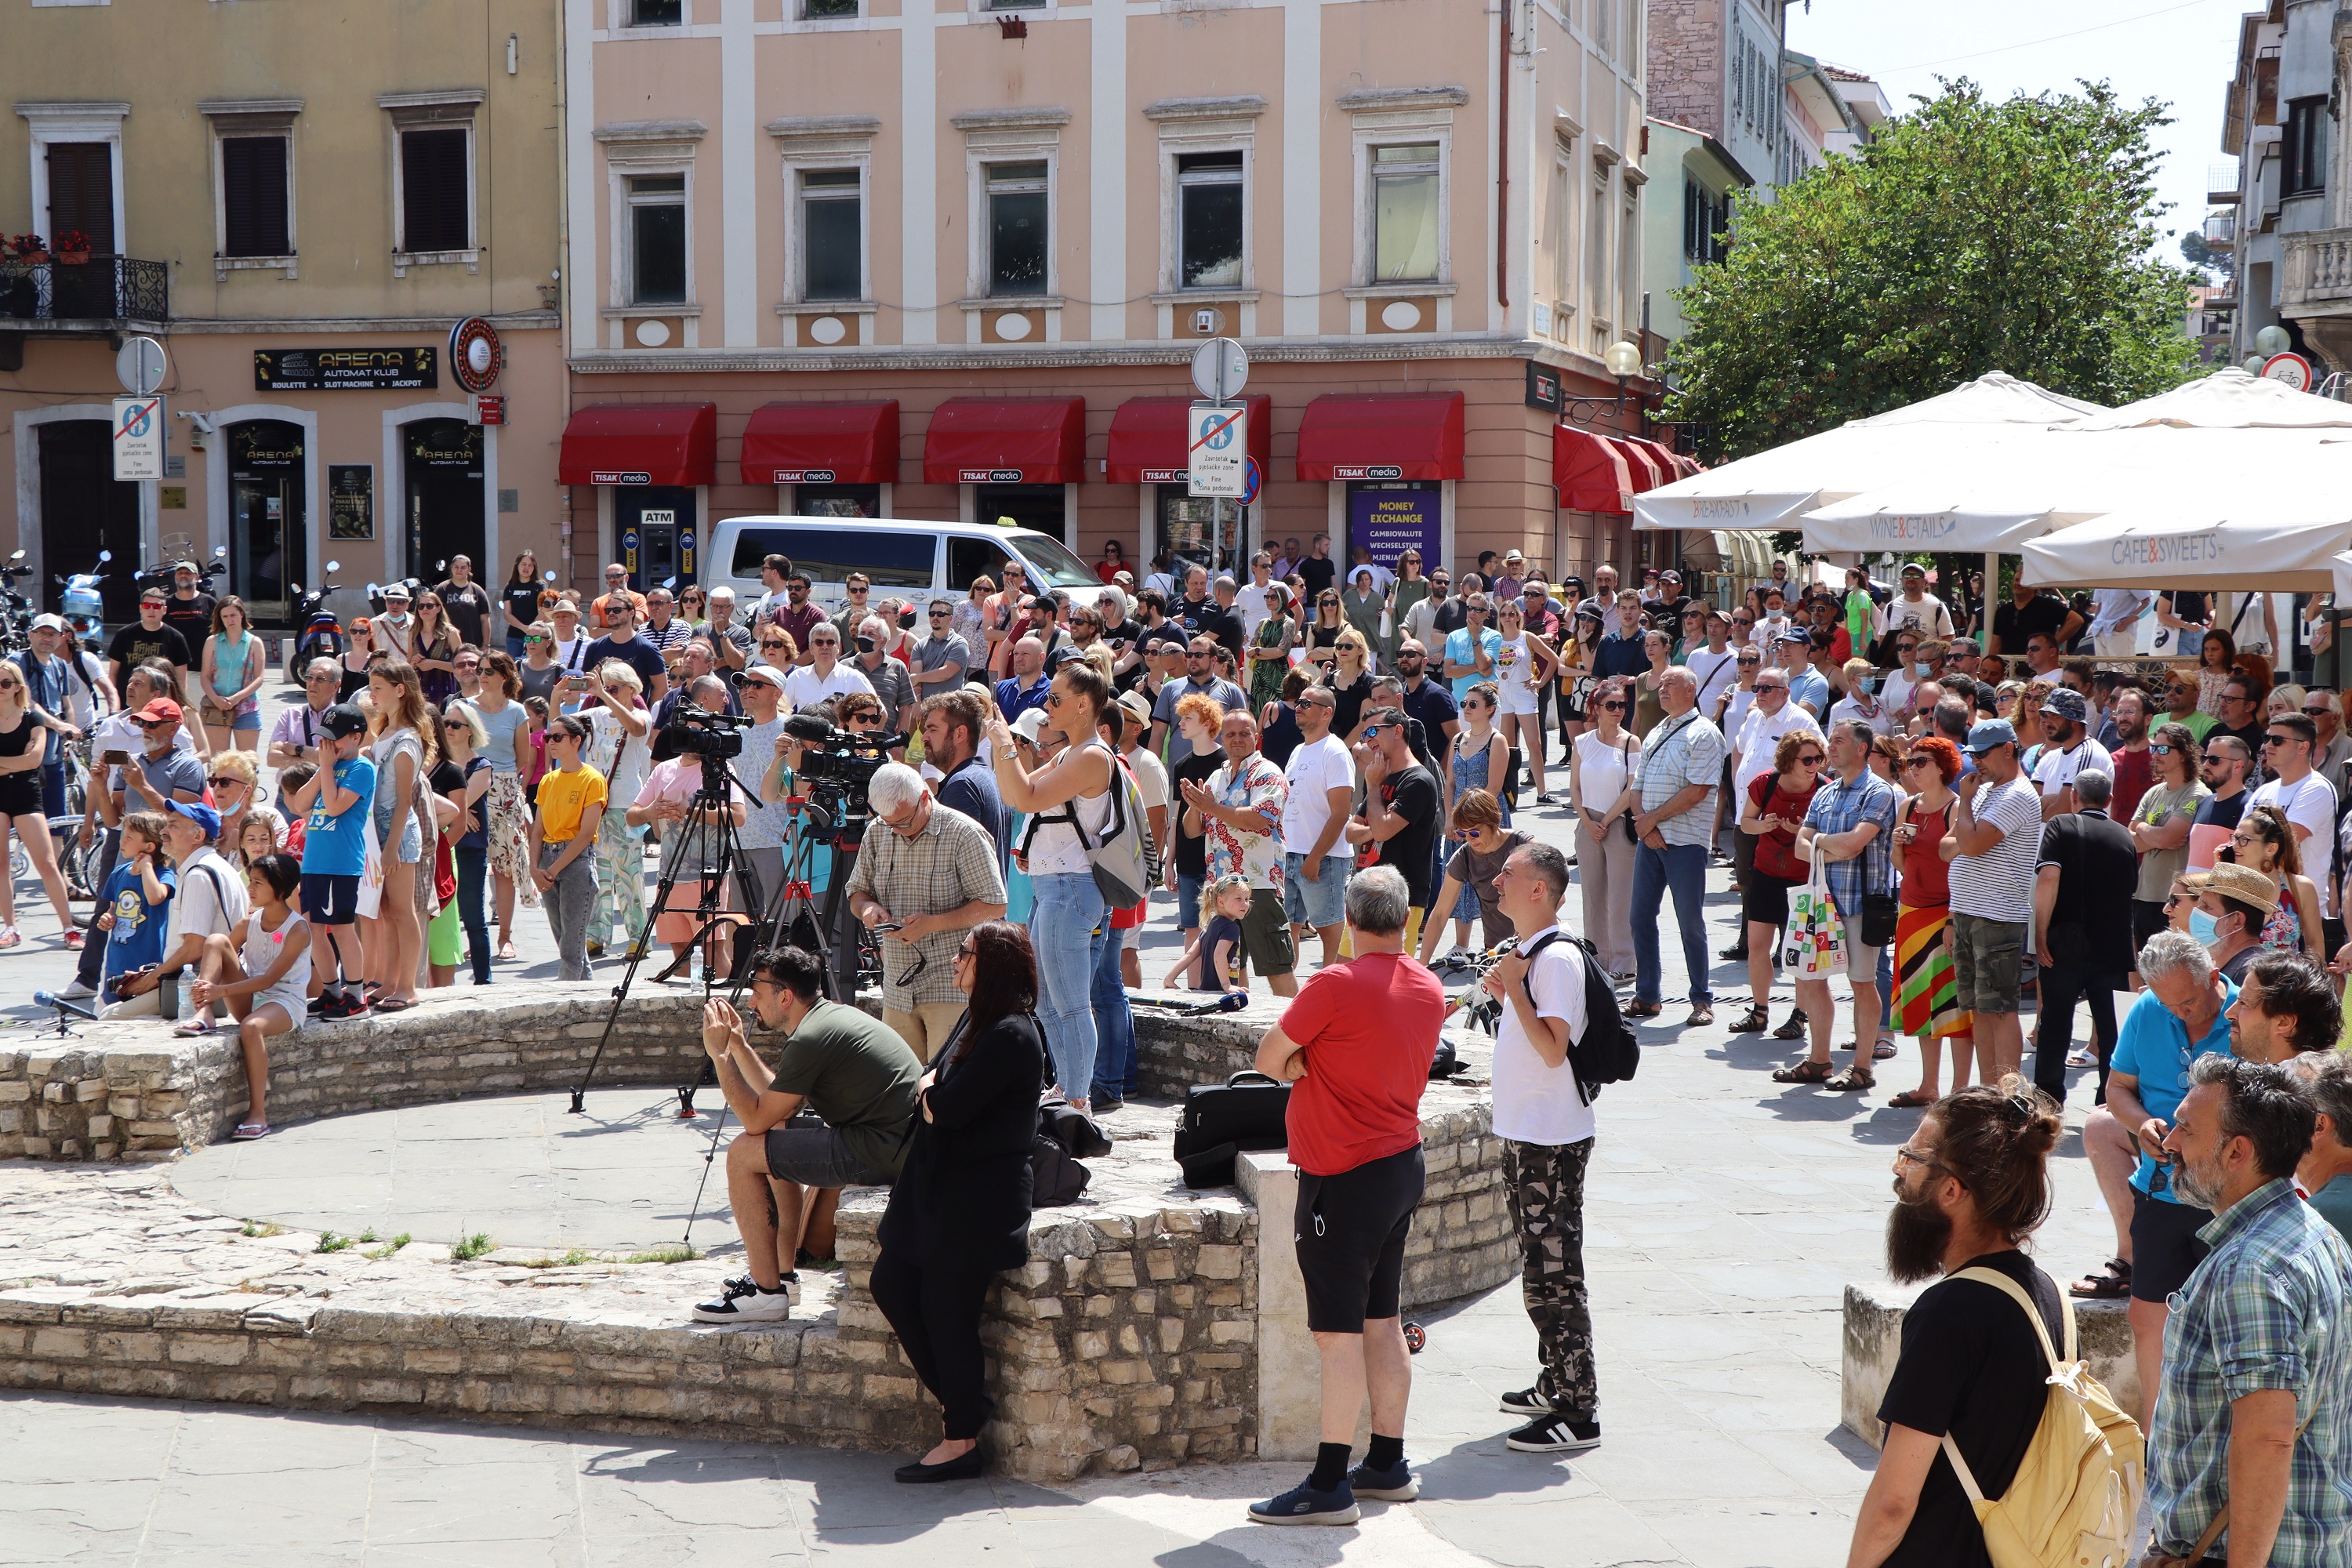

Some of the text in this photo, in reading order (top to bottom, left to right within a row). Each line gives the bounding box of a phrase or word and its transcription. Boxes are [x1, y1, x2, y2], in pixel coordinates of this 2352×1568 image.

[318, 351, 403, 367] ARENA
[324, 368, 372, 377] AUTOMAT
[993, 471, 1018, 480] media
[1378, 502, 1414, 511] MONEY
[1693, 499, 1740, 518] BREAKFAST
[645, 513, 672, 522] ATM
[1370, 514, 1423, 523] EXCHANGE
[1497, 651, 1517, 660] AVANA
